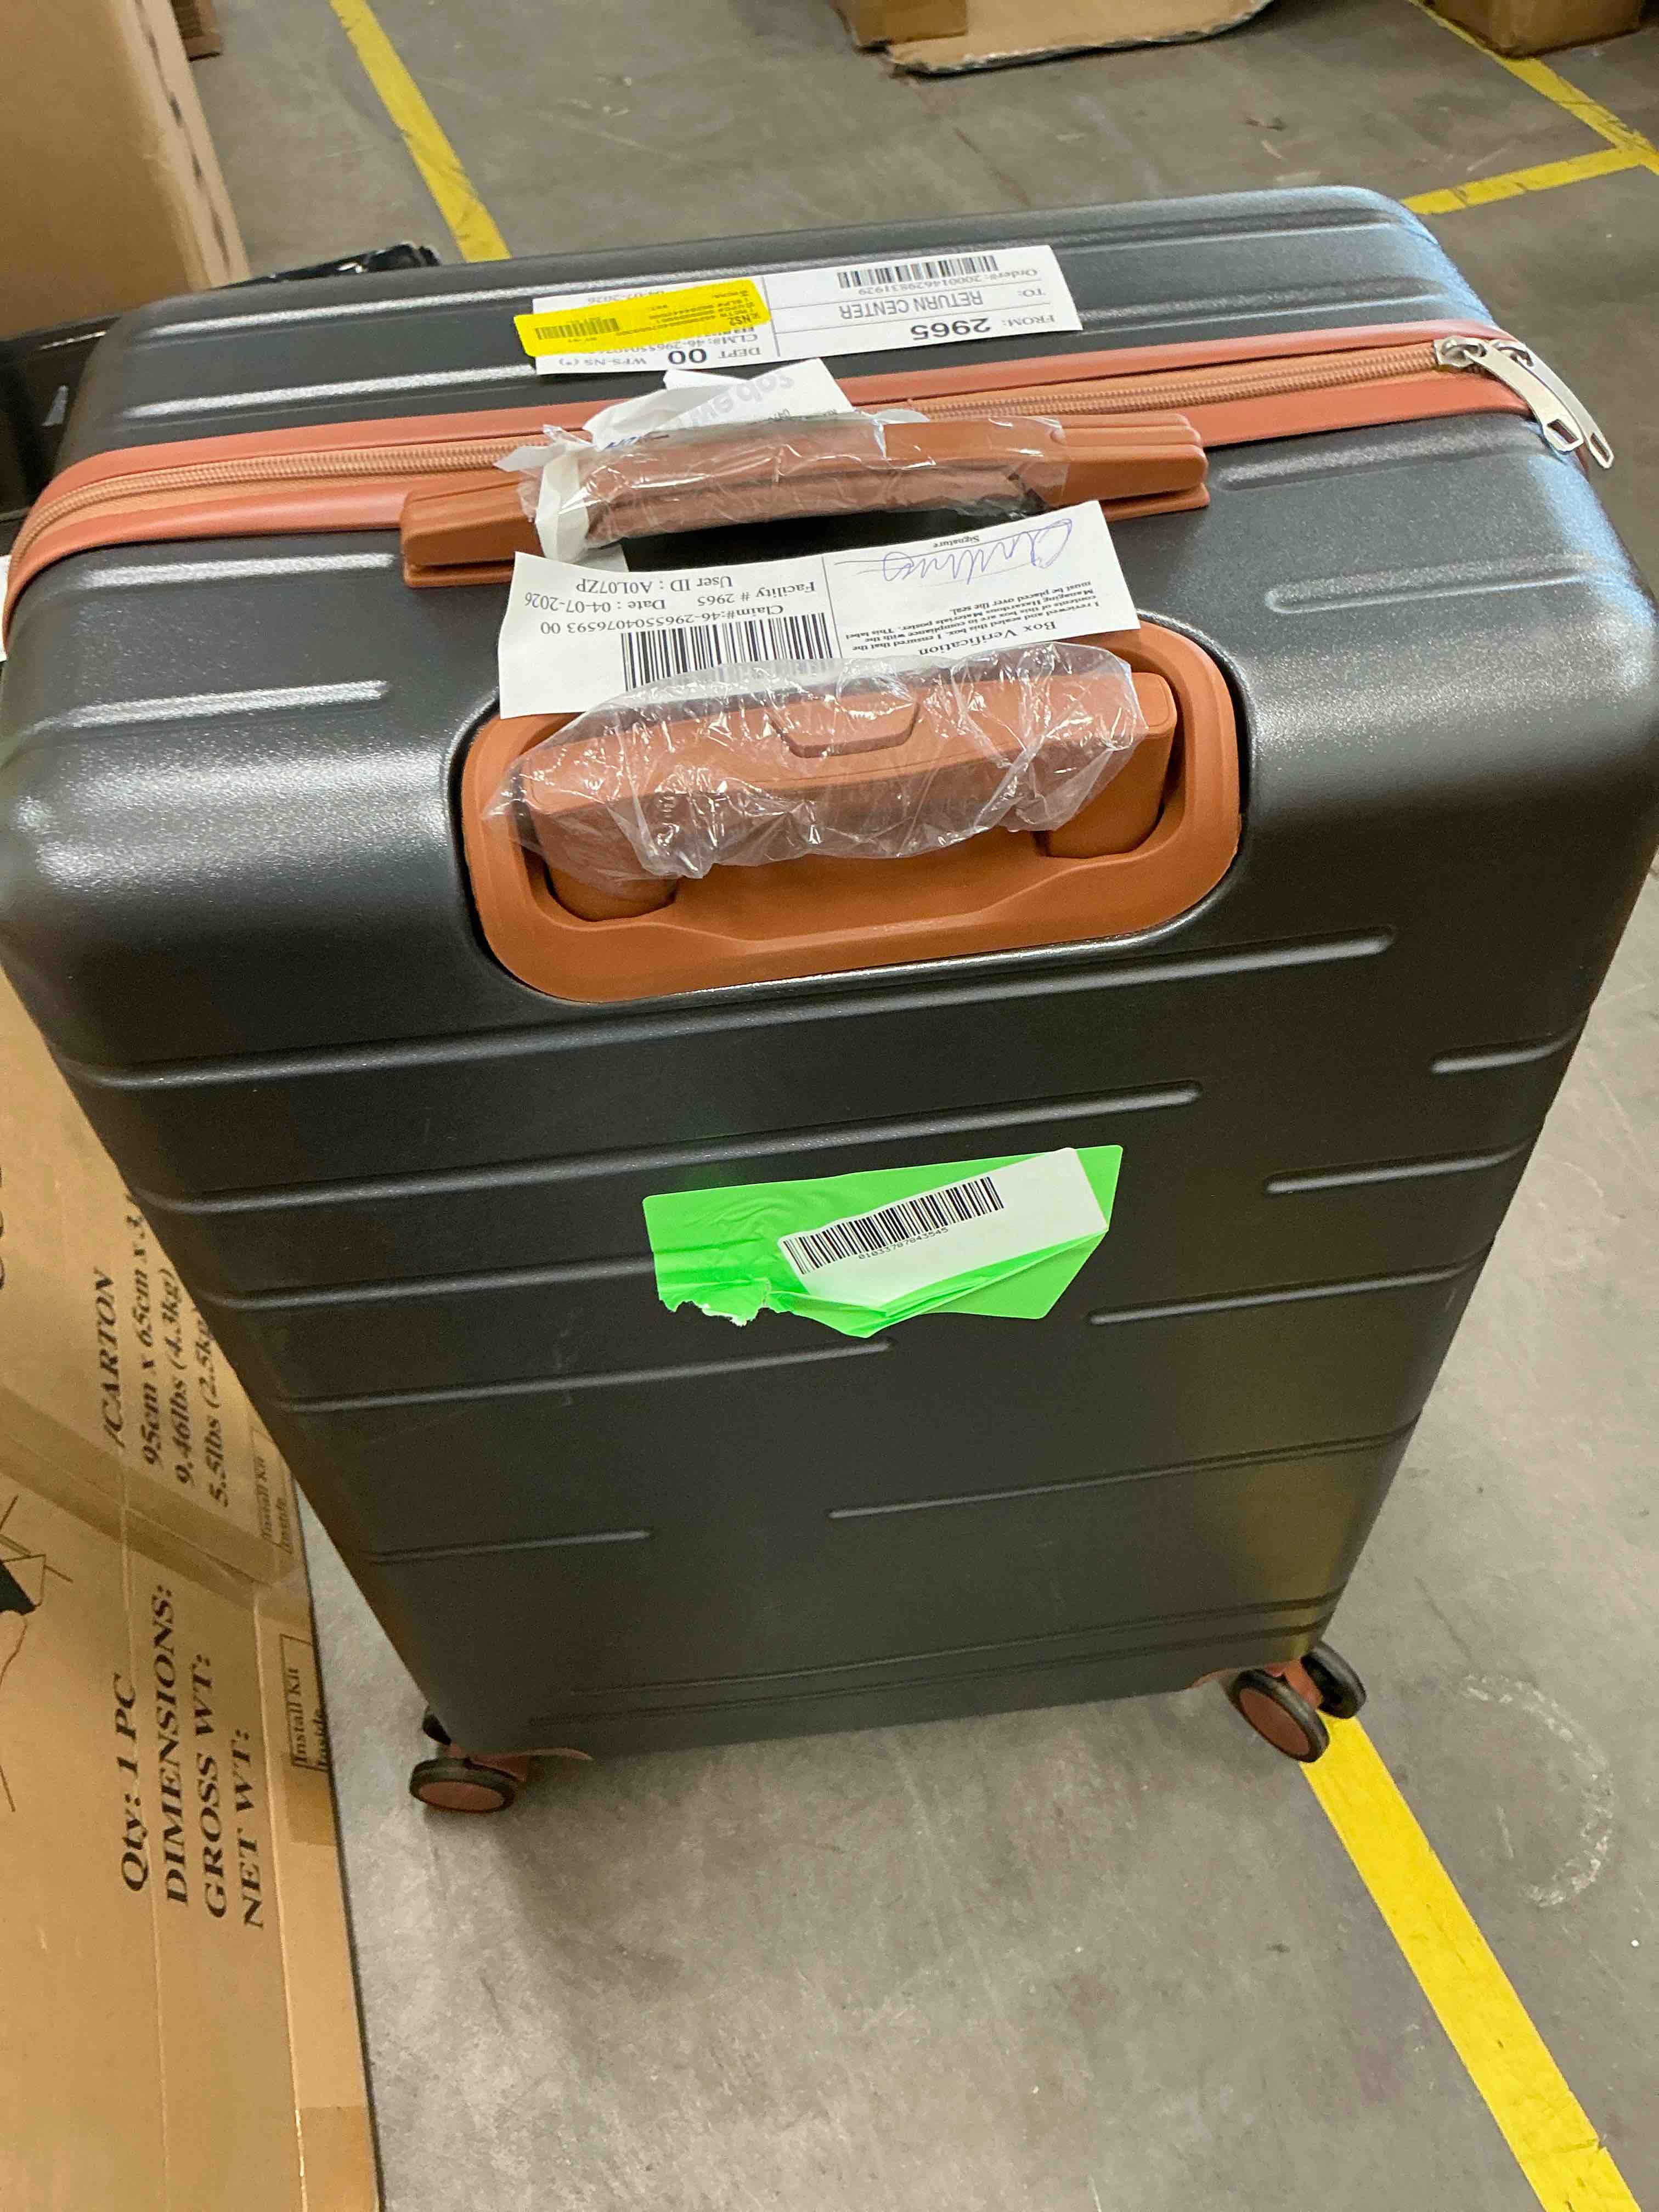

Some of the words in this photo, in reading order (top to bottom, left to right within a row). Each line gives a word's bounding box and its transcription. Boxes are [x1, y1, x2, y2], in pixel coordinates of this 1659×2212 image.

[1018, 287, 1043, 298] TO:
[912, 290, 984, 313] RETURN
[838, 300, 909, 320] CENTER
[1001, 314, 1057, 329] FROM:
[911, 318, 991, 341] 2965
[668, 348, 707, 365] 00
[718, 347, 761, 359] DEPT
[933, 535, 980, 549] Signature
[668, 579, 690, 592] ID
[695, 574, 733, 589] User
[1066, 581, 1092, 591] must
[740, 592, 751, 601] #
[755, 580, 815, 600] Facility
[1017, 589, 1049, 602] placed
[1042, 589, 1094, 603] Managing
[523, 591, 611, 613] 04-07-2026
[626, 598, 666, 612] Date
[696, 593, 735, 607] 2965
[985, 600, 1041, 613] Hazardous
[992, 597, 1015, 606] over
[1054, 595, 1097, 607] contents
[949, 606, 972, 616] seal.
[1019, 607, 1038, 615] this
[1046, 603, 1091, 616] reviewed
[898, 620, 933, 631] poster.
[936, 612, 984, 625] Materials
[990, 617, 1021, 627] sealed
[1023, 620, 1057, 632] Box
[539, 621, 560, 635] 00
[872, 628, 895, 636] This
[907, 621, 966, 637] compliance
[969, 624, 988, 633] this
[845, 632, 870, 640] label
[893, 636, 935, 647] ensured
[917, 629, 1019, 656] Verification
[871, 641, 891, 650] that
[132, 1269, 155, 1348] 65cm
[159, 1268, 187, 1370] (4.3kg)
[92, 1265, 125, 1450] /CARTON
[140, 1356, 155, 1373] x
[141, 1382, 162, 1466] 95cm
[168, 1380, 193, 1485] 9.46lbs
[202, 1409, 229, 1509] 5.5lbs
[285, 1667, 301, 1696] Kit
[190, 1654, 215, 1739] WT:
[112, 1671, 137, 1742] PC
[286, 1701, 308, 1764] Install
[150, 1584, 189, 1907] DIMENSIONS:
[116, 1754, 138, 1779] 1
[229, 1728, 255, 1813] WT:
[120, 1792, 149, 1892] Qty:
[195, 1752, 228, 1918] GROSS
[235, 1827, 264, 1931] NET
